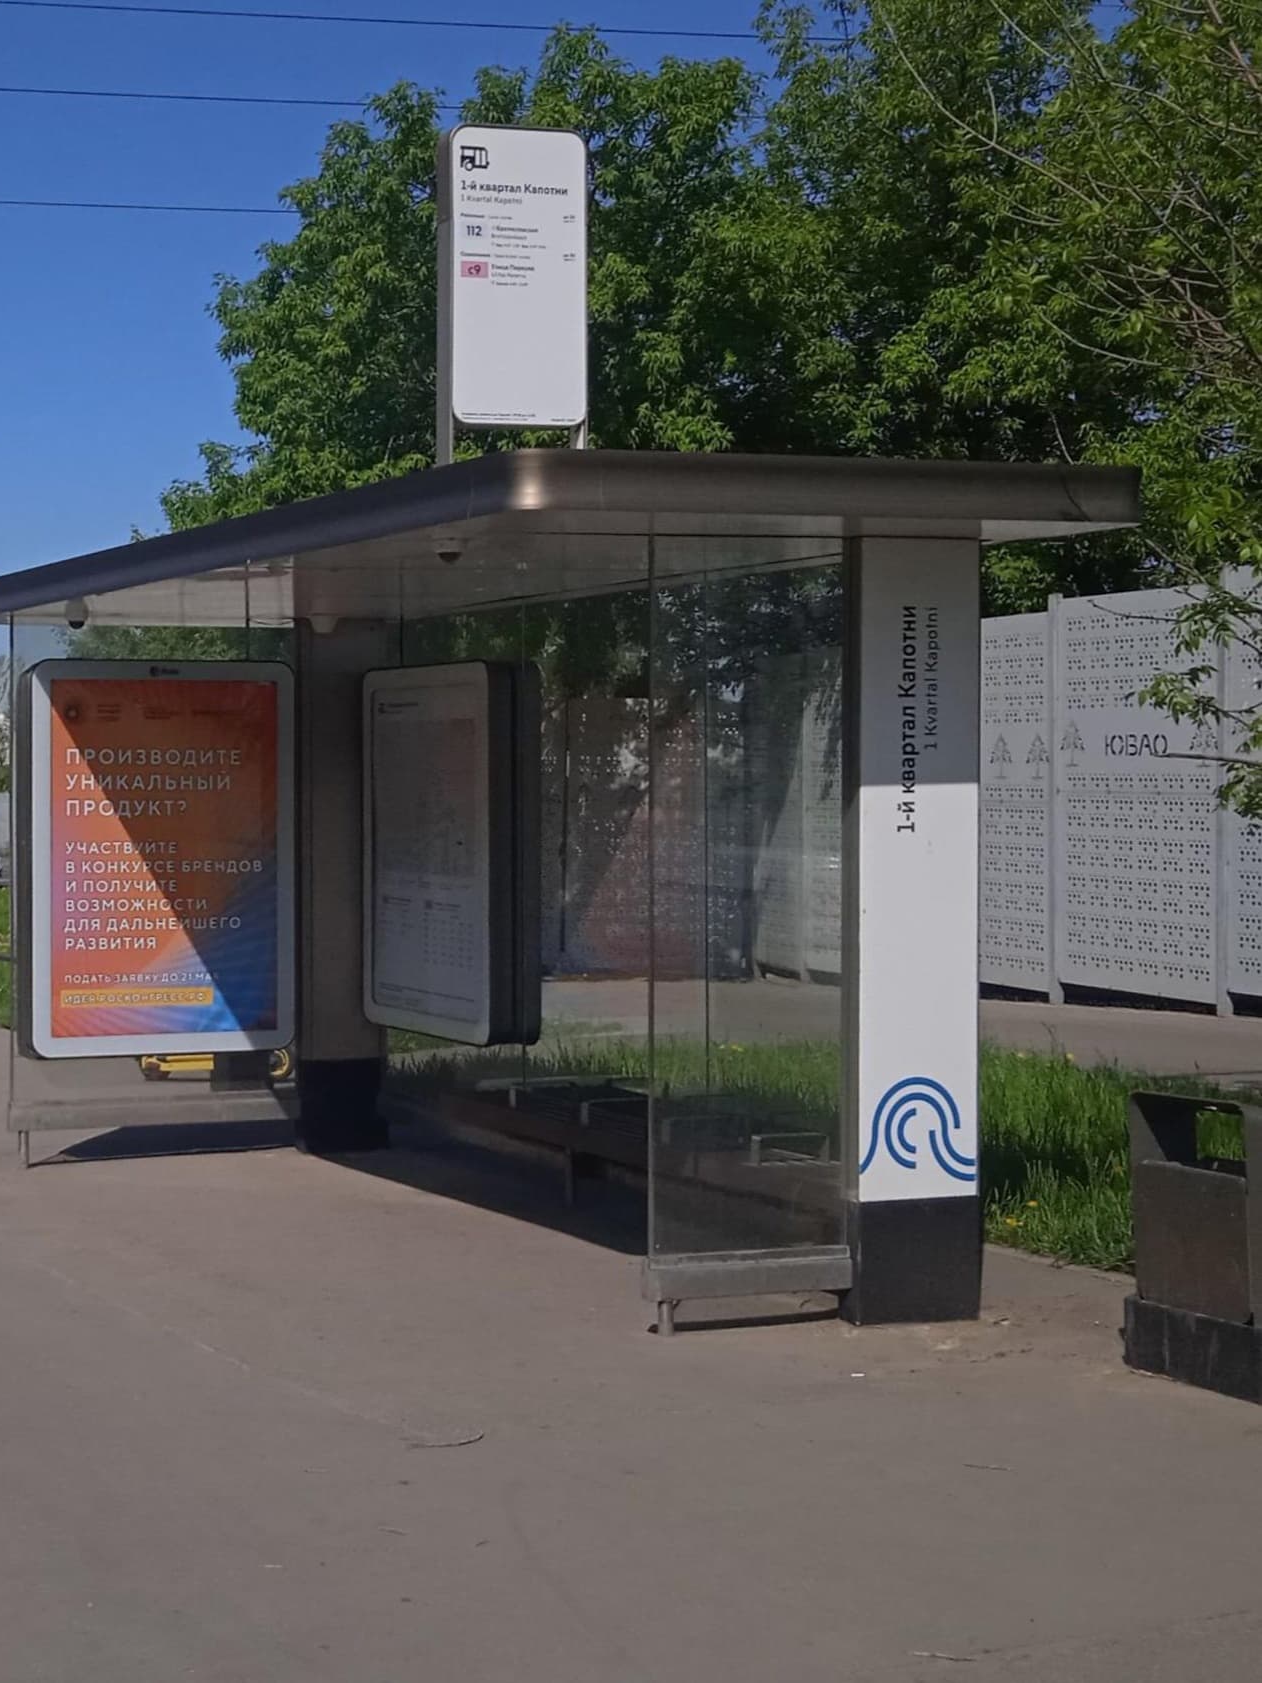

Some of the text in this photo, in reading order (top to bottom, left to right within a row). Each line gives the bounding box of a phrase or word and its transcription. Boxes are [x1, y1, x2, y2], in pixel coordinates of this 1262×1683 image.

[460, 179, 568, 196] 1-й квартал Капотни
[466, 225, 482, 237] 112
[924, 678, 938, 736] Kvartal
[896, 605, 920, 833] 1-й квартал Капотни
[924, 742, 938, 751] 1
[1104, 733, 1168, 757] ЮВАО
[65, 748, 242, 767] ПРОИЗВОДИТЕ
[65, 771, 231, 791] УНИКАЛЬНЫЙ
[65, 800, 187, 818] ПРОДУКТ?
[65, 840, 178, 855] УЧАСТВУЙТЕ
[65, 859, 264, 874] В КОНКУРСЕ БРЕНДОВ
[65, 880, 178, 893] И ПОЛУЧИТЕ
[65, 898, 208, 912] ВОЗМОЖНОСТИ
[64, 916, 242, 934] ДЛЯ ДАЛЬНЕЙШЕГО
[65, 936, 157, 950] РАЗВИТИЯ
[64, 974, 111, 984] ПОДАТЬ
[113, 974, 158, 983] ЗАЯВКУ
[161, 973, 179, 982] ДО
[181, 973, 192, 981] 21
